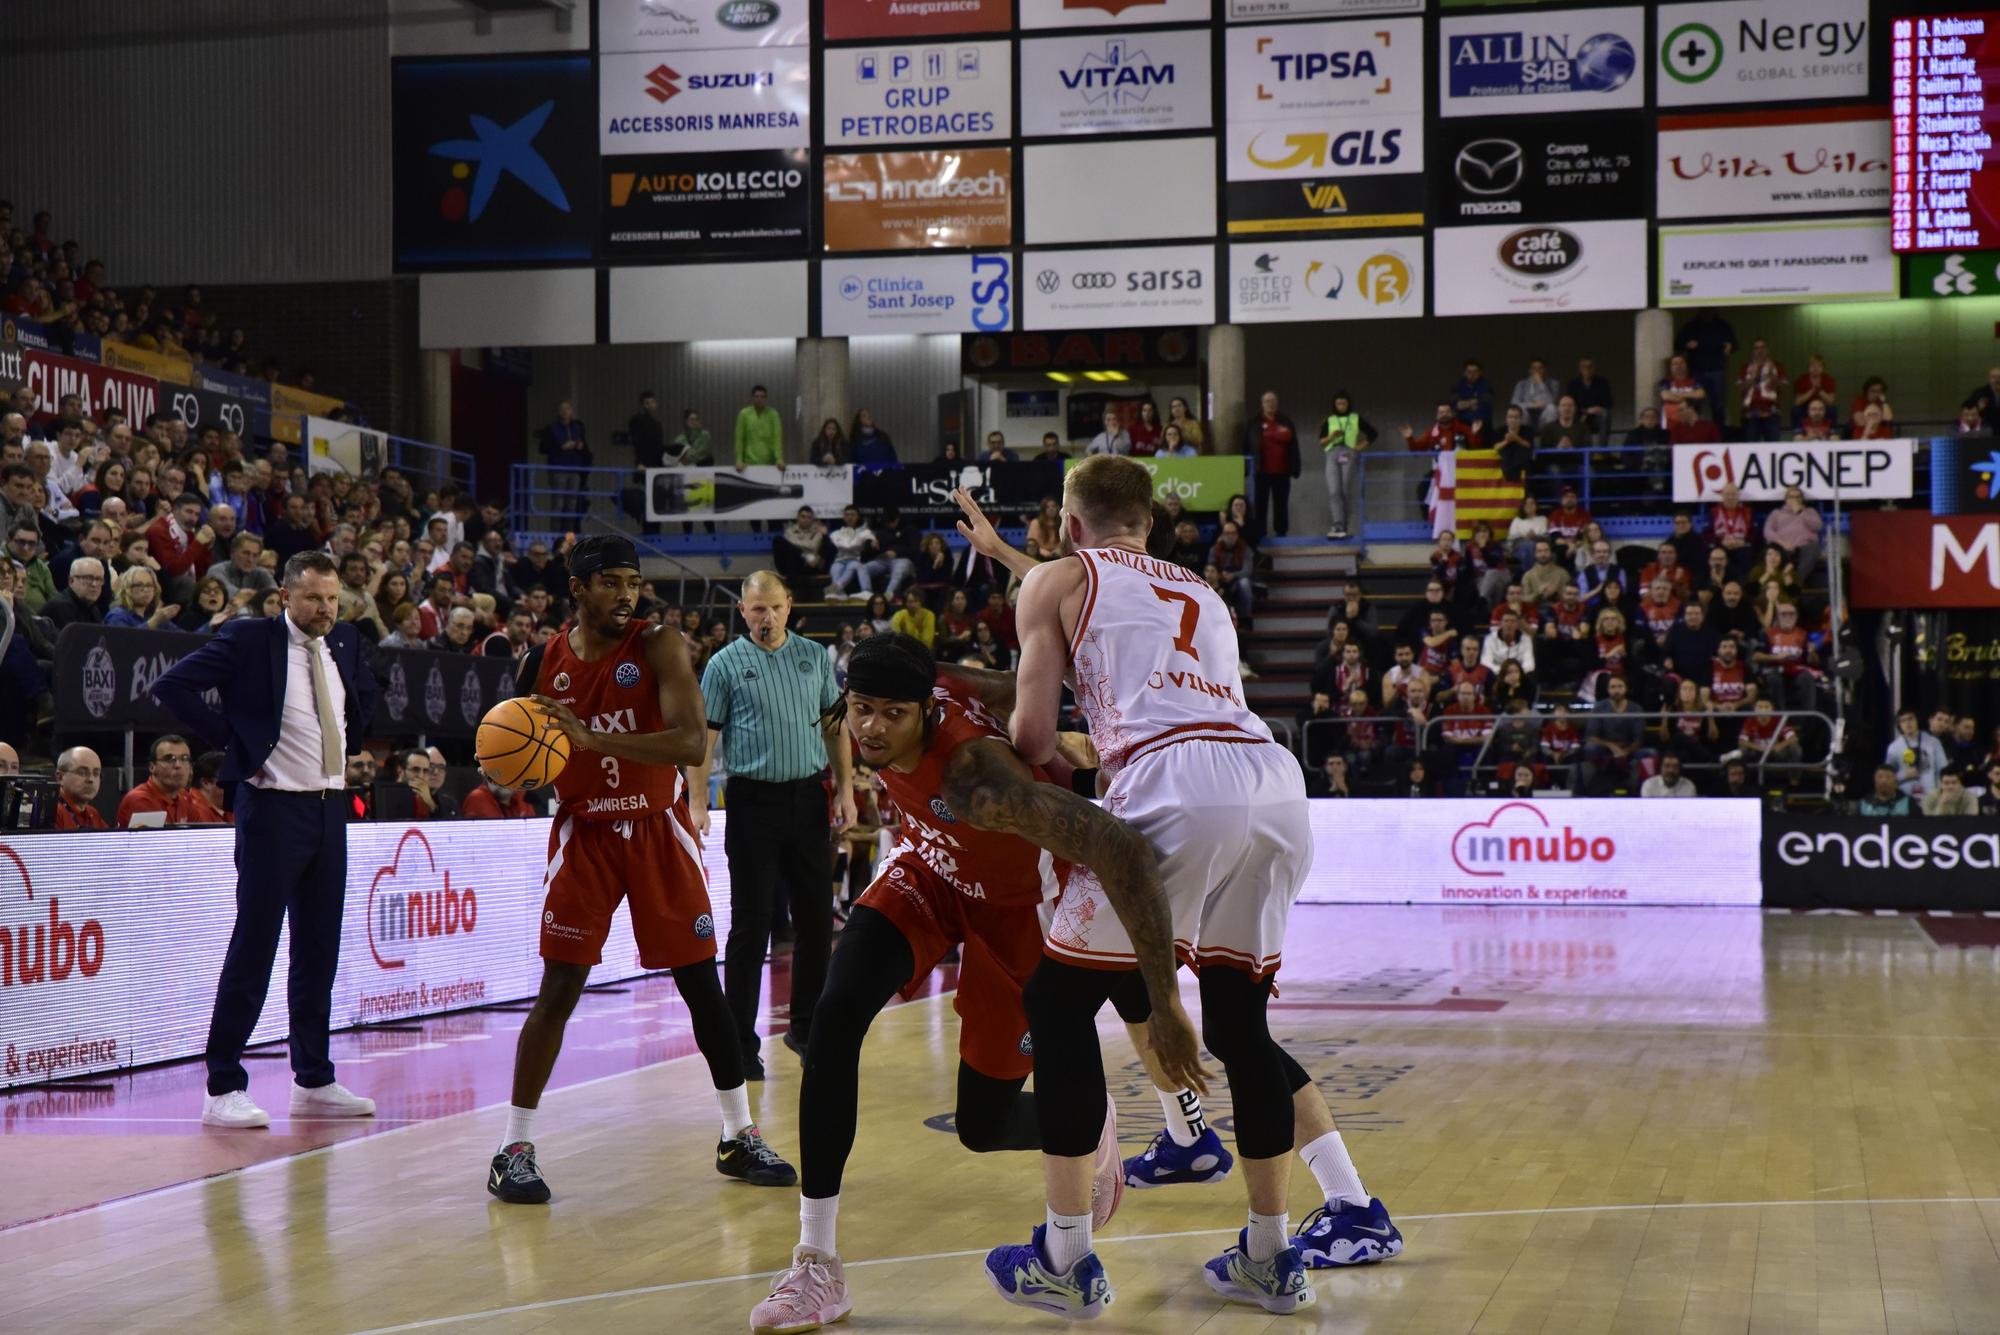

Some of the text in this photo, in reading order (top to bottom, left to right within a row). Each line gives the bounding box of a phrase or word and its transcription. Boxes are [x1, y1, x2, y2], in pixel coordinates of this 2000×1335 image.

[1932, 17, 1984, 36] Robinson
[1739, 18, 1866, 57] Nergy
[1455, 34, 1570, 65] ALL IN
[1271, 50, 1377, 81] TIPSA
[1522, 60, 1571, 83] S4B
[1736, 63, 1866, 82] GLOBAL SERVICE
[1929, 55, 1976, 76] Harding
[688, 72, 773, 90] SUZUKI
[1059, 64, 1175, 89] VITAM
[1917, 76, 1961, 95] Guillem
[1963, 74, 1982, 93] Jou
[885, 87, 950, 109] GRUP
[1470, 82, 1572, 97] Protecció de Dades
[1917, 95, 1945, 115] Dani
[609, 112, 799, 135] ACCESSORIS MANRESA
[841, 112, 994, 137] PETROBAGES
[1917, 113, 1982, 134] Steinbergs
[1331, 128, 1402, 167] GLS
[1546, 144, 1588, 155] Camps
[1575, 157, 1590, 169] de
[1616, 156, 1631, 168] 75
[1782, 147, 1890, 175] Vila
[638, 169, 802, 194] AUTOKOLECCIO
[1930, 171, 1971, 190] Ferrari
[1771, 186, 1891, 202] www.vilavila.com
[1893, 192, 1911, 210] 22
[1893, 211, 1911, 230] 23
[1517, 230, 1561, 251] café
[1893, 230, 1911, 250] 55
[1917, 230, 1945, 249] Dani
[1512, 250, 1567, 266] crem
[1748, 259, 1770, 269] QUE
[1850, 255, 1869, 265] FER
[867, 276, 924, 293] Clínica
[1126, 269, 1203, 292] sarsa
[1239, 275, 1292, 290] OSTEO
[867, 293, 955, 311] Sant Josep
[1239, 290, 1292, 305] SPORT
[16, 328, 49, 348] Manresa
[1012, 334, 1145, 366] BAR
[1739, 450, 1892, 489] AIGNEP
[1149, 582, 1200, 662] 7
[85, 669, 114, 689] BAXI
[600, 756, 621, 789] 3
[587, 793, 649, 813] MANRESA
[1468, 826, 1616, 862] innubo
[1777, 823, 2000, 869] endesa
[1441, 884, 1628, 904] innovation & experience
[380, 870, 477, 942] innubo
[360, 977, 486, 1018] innovation & experience
[6, 1035, 117, 1079] & experience
